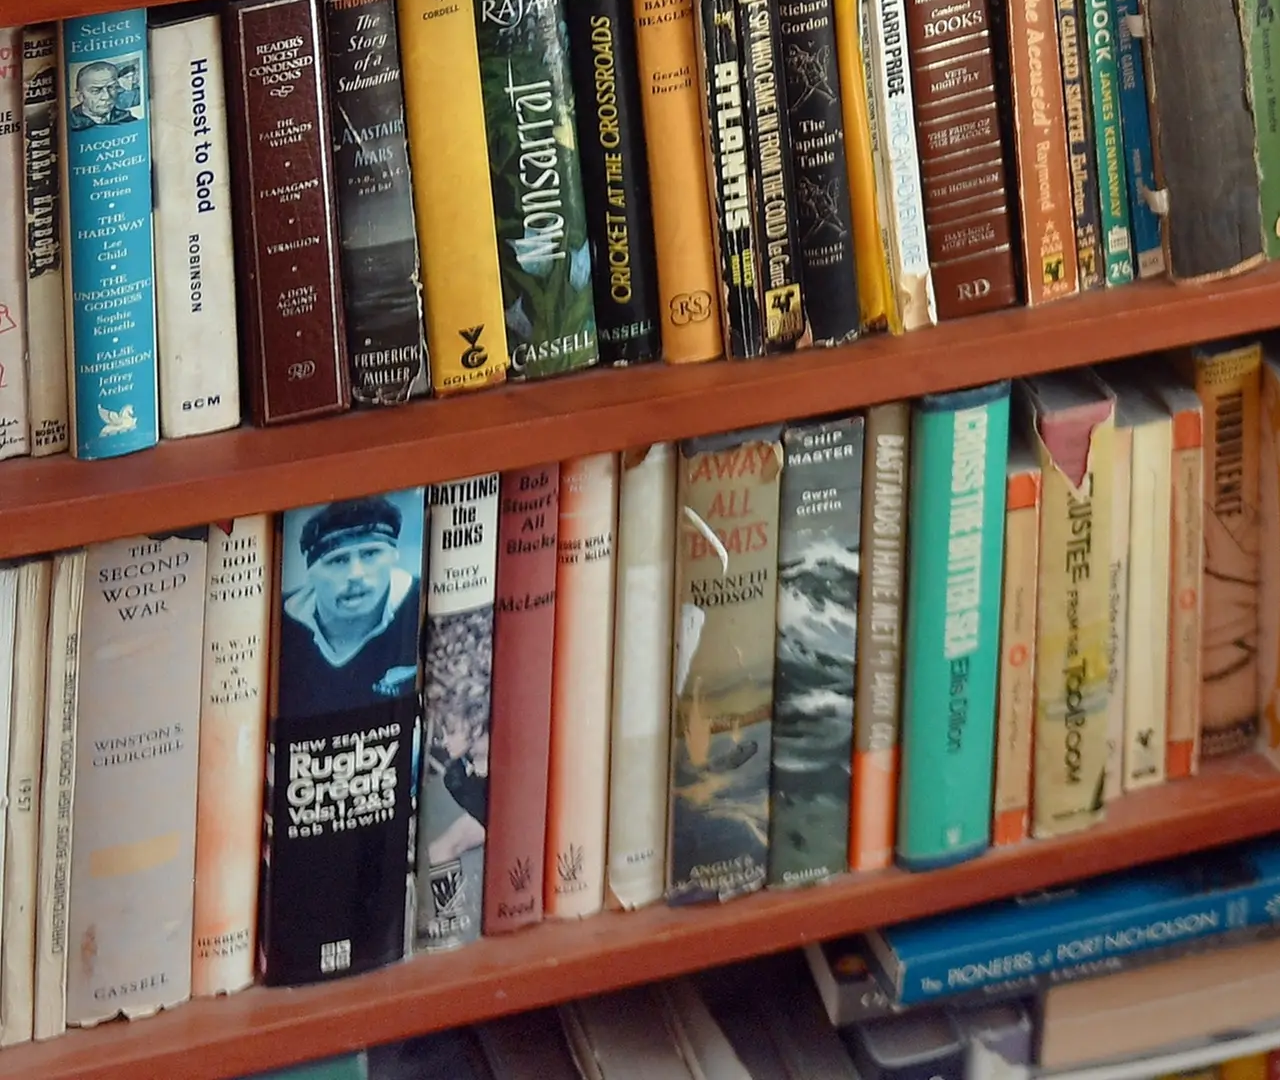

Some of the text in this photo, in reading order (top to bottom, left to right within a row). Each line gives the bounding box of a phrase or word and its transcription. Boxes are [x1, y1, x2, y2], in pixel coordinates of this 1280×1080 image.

[422, 4, 460, 20] CORDELL
[80, 20, 131, 37] Select
[356, 14, 380, 32] The
[781, 15, 829, 34] Gordon
[923, 10, 983, 38] BOOKS
[72, 34, 141, 53] Editions
[256, 36, 304, 55] READER'S
[348, 32, 387, 52] Story
[263, 49, 299, 64] DIGEST
[354, 51, 371, 71] of
[263, 70, 302, 86] BOOKS
[652, 66, 690, 82] Gerald
[885, 47, 905, 98] PRICE
[651, 78, 693, 95] Durrell
[1099, 73, 1114, 121] JAMES
[190, 58, 215, 213] Honest to God
[749, 14, 788, 238] SPY WHO CAME IN FROM THE COLD
[799, 118, 826, 133] The
[79, 133, 139, 153] JACQUOT
[714, 60, 750, 232] ATLANTIS
[796, 130, 843, 151] aptain's
[73, 155, 146, 175] THE ANGEL
[95, 149, 125, 161] AND
[504, 58, 566, 263] Monsarrat
[591, 16, 632, 304] CRICKET AT THE CROSSROADS
[798, 152, 836, 169] Table
[93, 174, 129, 186] Martin
[1035, 142, 1055, 213] Raymond
[1104, 126, 1121, 217] KENNAWAY
[90, 186, 131, 201] O'Brien
[98, 212, 126, 224] THE
[78, 218, 145, 240] HARD WAY
[97, 249, 128, 262] Child
[103, 240, 123, 251] Lee
[100, 274, 128, 286] THE
[188, 234, 202, 313] ROBINSON
[957, 278, 991, 302] RD
[354, 345, 419, 368] FREDERICK
[512, 330, 594, 370] CASSELL
[363, 367, 411, 385] MULLER
[36, 433, 66, 446] HEAD
[803, 431, 843, 448] SHIP
[690, 441, 775, 484] AWAY
[788, 444, 854, 468] MASTER
[519, 475, 550, 492] Bob
[706, 488, 752, 519] ALL
[802, 488, 837, 503] Gwyn
[452, 504, 476, 527] the
[796, 499, 842, 516] Griffin
[521, 515, 546, 533] All
[221, 536, 257, 552] THE
[442, 524, 483, 551] BOKS
[506, 533, 557, 556] Blacks
[871, 433, 905, 646] BASTARDS HAVE MET
[128, 542, 162, 559] THE
[222, 552, 257, 568] BOB
[99, 552, 189, 584] SECOND
[211, 566, 265, 586] SCOTT
[443, 565, 480, 580] Terry
[101, 573, 187, 604] WORLD
[433, 576, 488, 595] McLean
[690, 568, 768, 594] KENNETH
[209, 582, 265, 602] STORY
[693, 585, 764, 608] DODSON
[118, 599, 168, 623] WAR
[947, 699, 968, 756] Dillon
[94, 726, 170, 752] WINSTON
[290, 723, 401, 755] NEW ZEALAND
[93, 740, 183, 767] CHURCHILL
[289, 738, 399, 781] Rugby
[286, 766, 397, 807] Greats
[288, 824, 324, 838] Bob
[947, 950, 1035, 988] PIONEERS
[1056, 933, 1104, 963] PORT
[1104, 909, 1220, 951] NICHOLSON
[94, 973, 169, 1001] CASSELL
